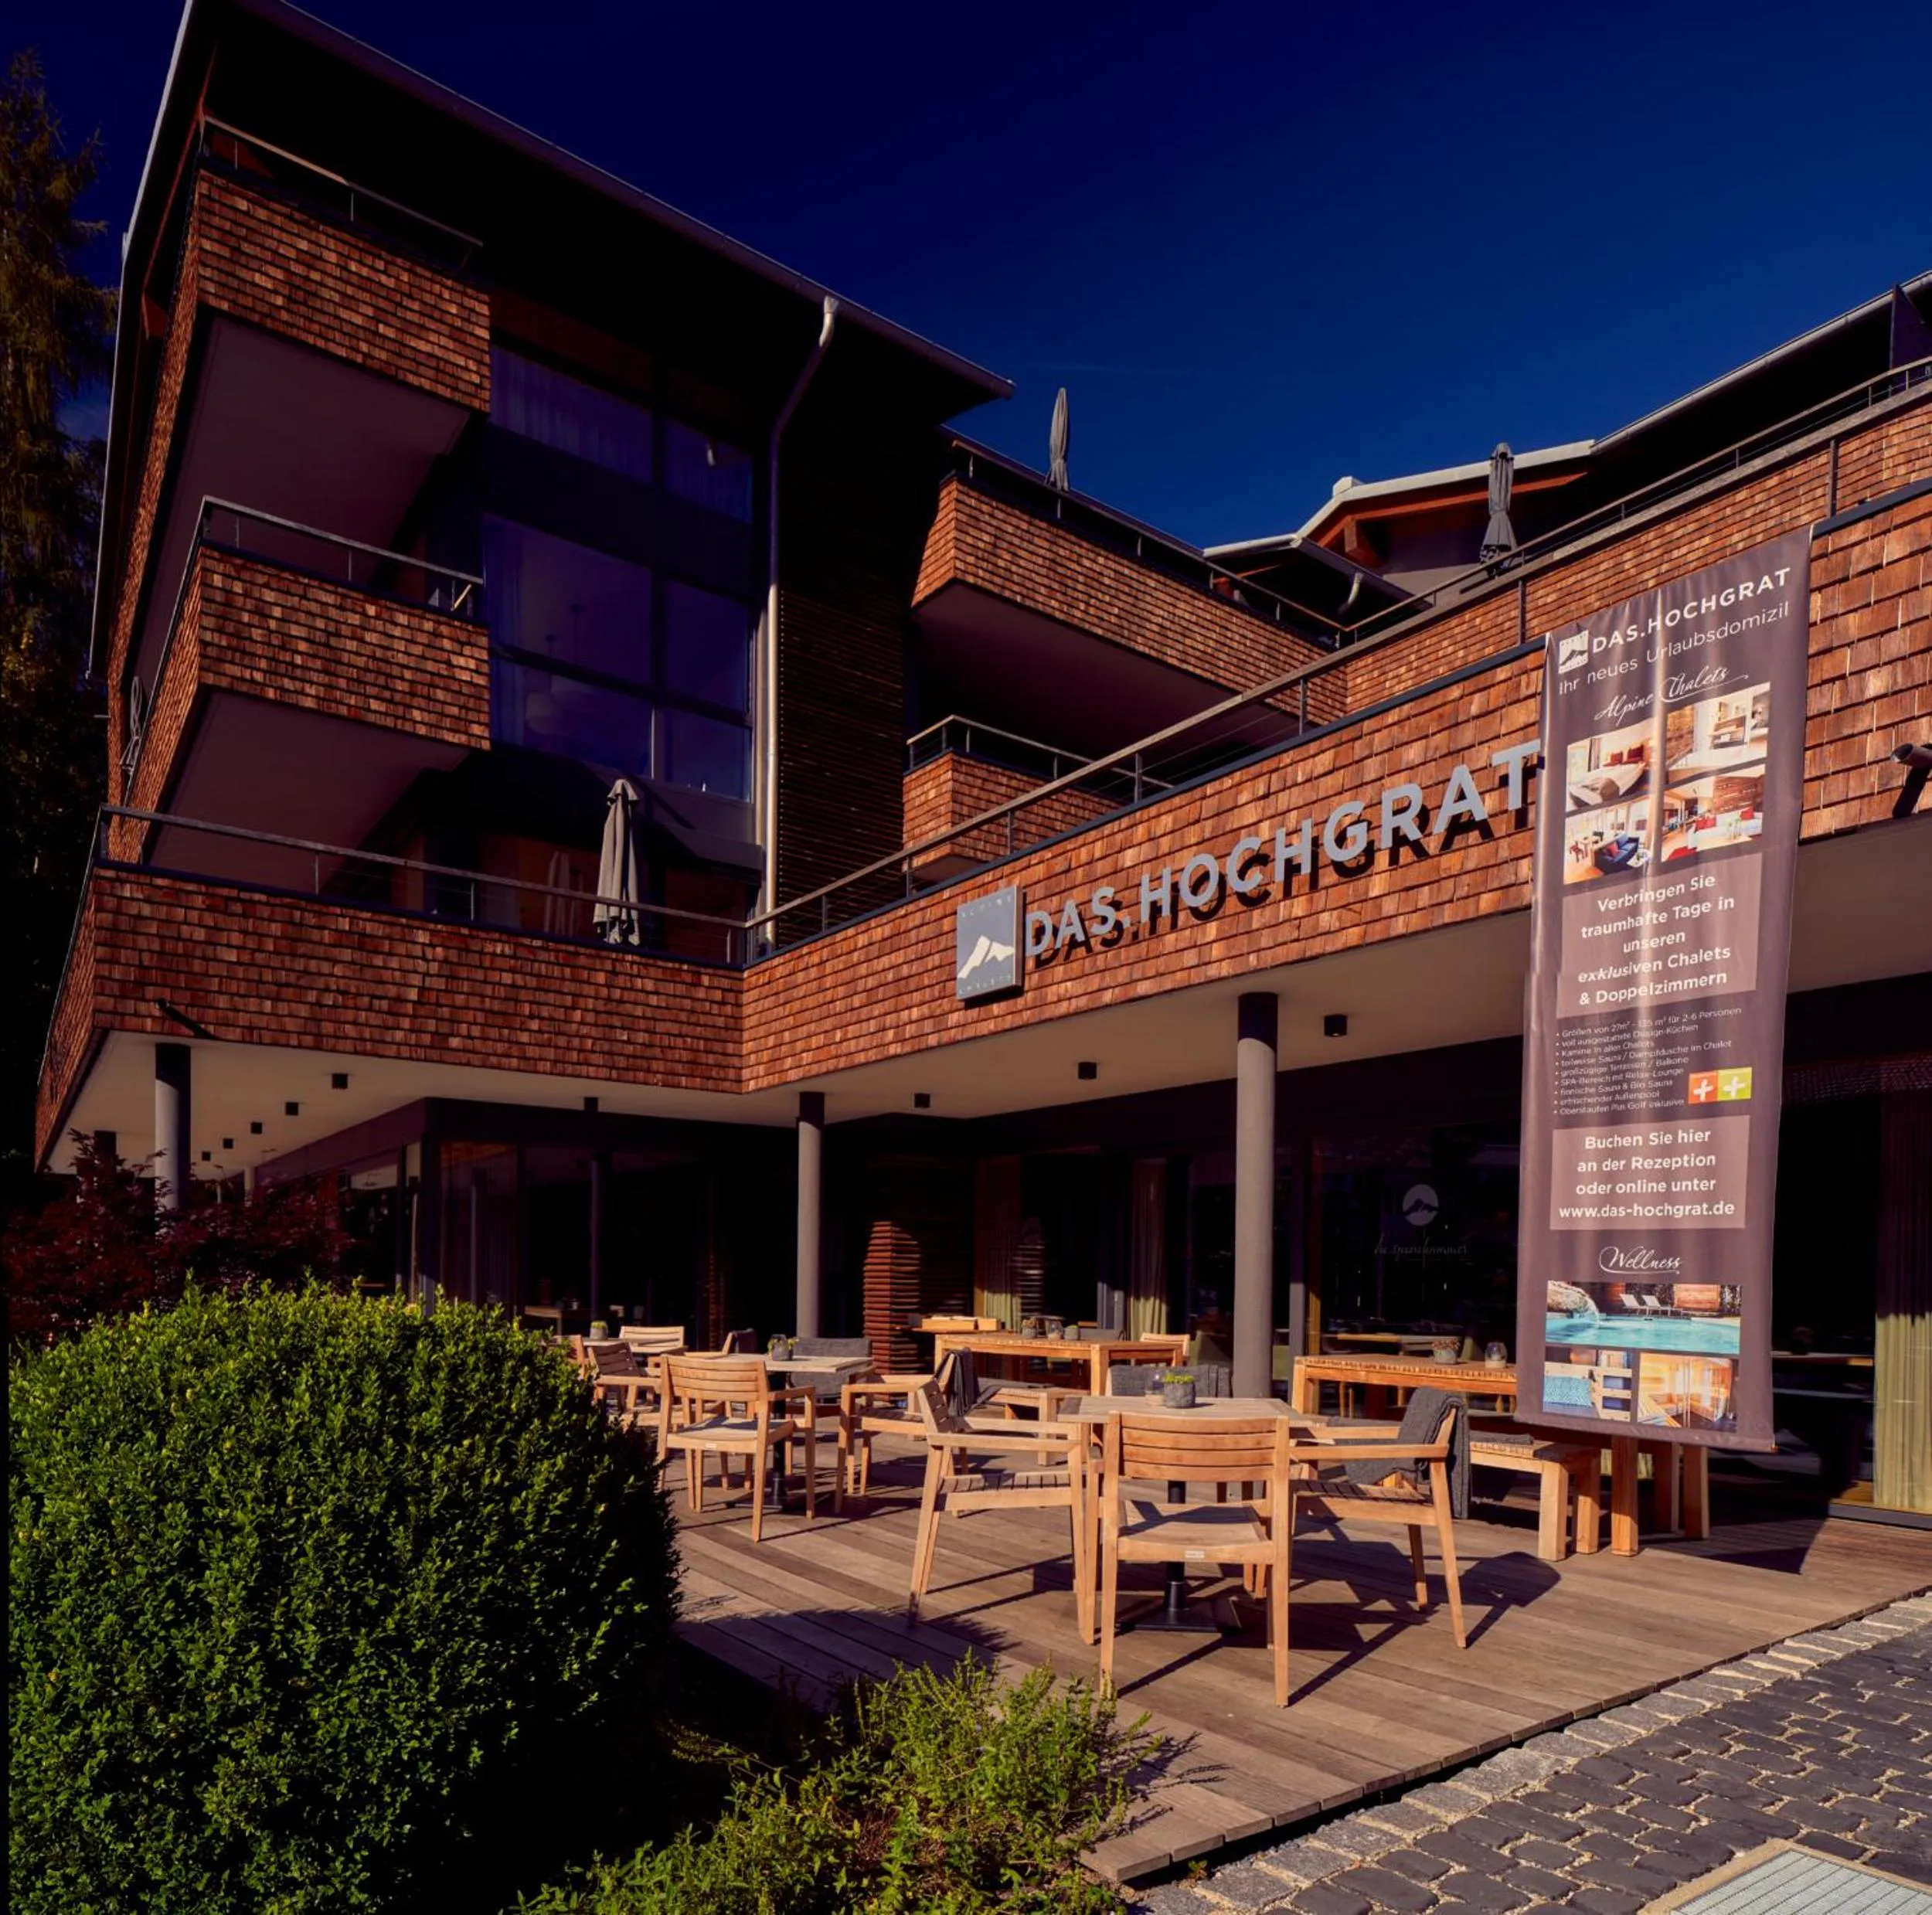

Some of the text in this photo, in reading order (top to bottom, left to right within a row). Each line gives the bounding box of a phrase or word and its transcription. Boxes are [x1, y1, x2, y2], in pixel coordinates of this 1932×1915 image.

[1592, 567, 1791, 653] DAS.HOCHGRAT
[1559, 676, 1580, 695] Ihr
[1587, 658, 1638, 685] neues
[1646, 600, 1789, 663] Urlaubsdomizil
[1594, 691, 1655, 726] Alpine
[1026, 740, 1542, 957] DAS.HOCHGRAT
[1597, 874, 1716, 911] Verbringen Sie
[1581, 896, 1735, 939] traumhafte Tage in
[1623, 930, 1685, 953] unseren
[1577, 945, 1731, 983] exklusiven Chalets
[1579, 972, 1727, 1005] & Doppelzimmern
[1585, 1128, 1711, 1150] Buchen Sie hier
[1577, 1153, 1716, 1172] an der Rezeption
[1576, 1178, 1716, 1196] oder online unter
[1559, 1201, 1735, 1218] www.das-hochgrat.de
[1599, 1246, 1682, 1274] Wellness
